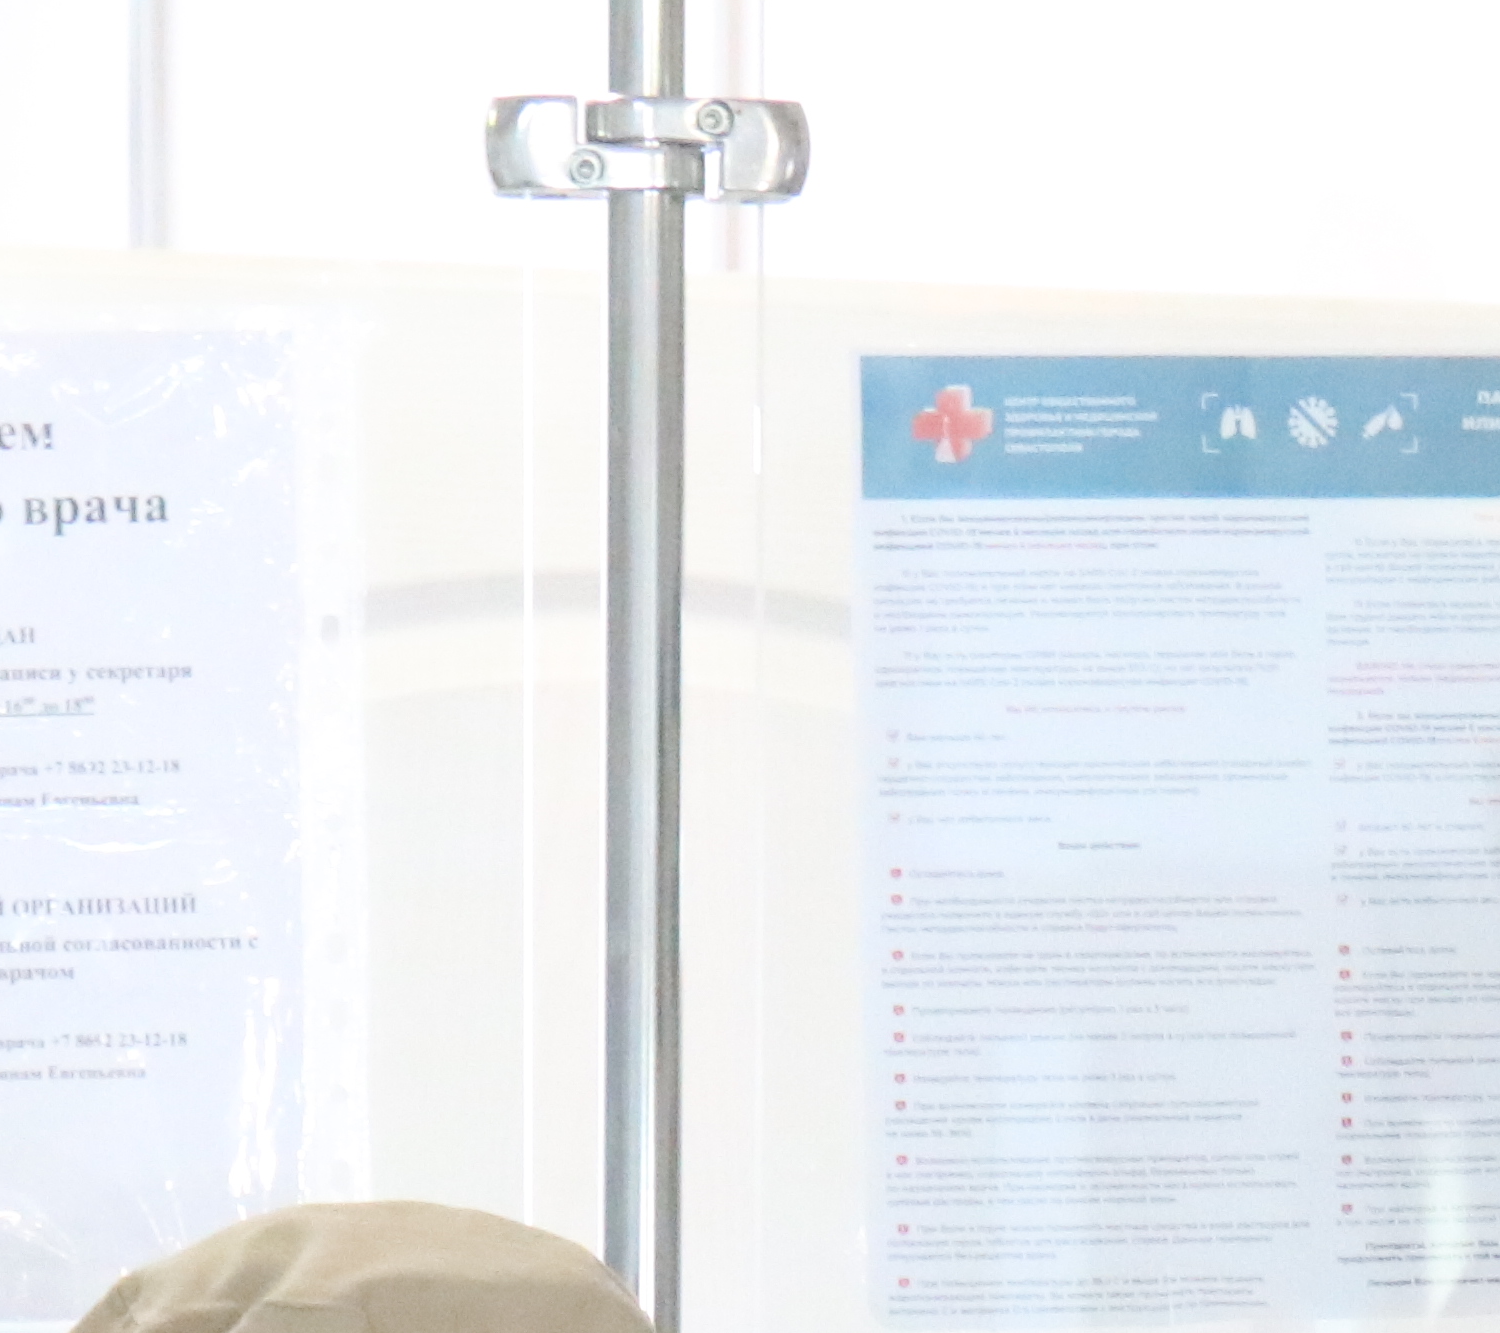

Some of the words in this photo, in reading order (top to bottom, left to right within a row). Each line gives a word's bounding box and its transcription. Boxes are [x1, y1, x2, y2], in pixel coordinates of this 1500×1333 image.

[23, 493, 169, 537] врача
[85, 663, 194, 685] секретаря
[12, 891, 197, 917] ОРГАНИЗАЦИЙ
